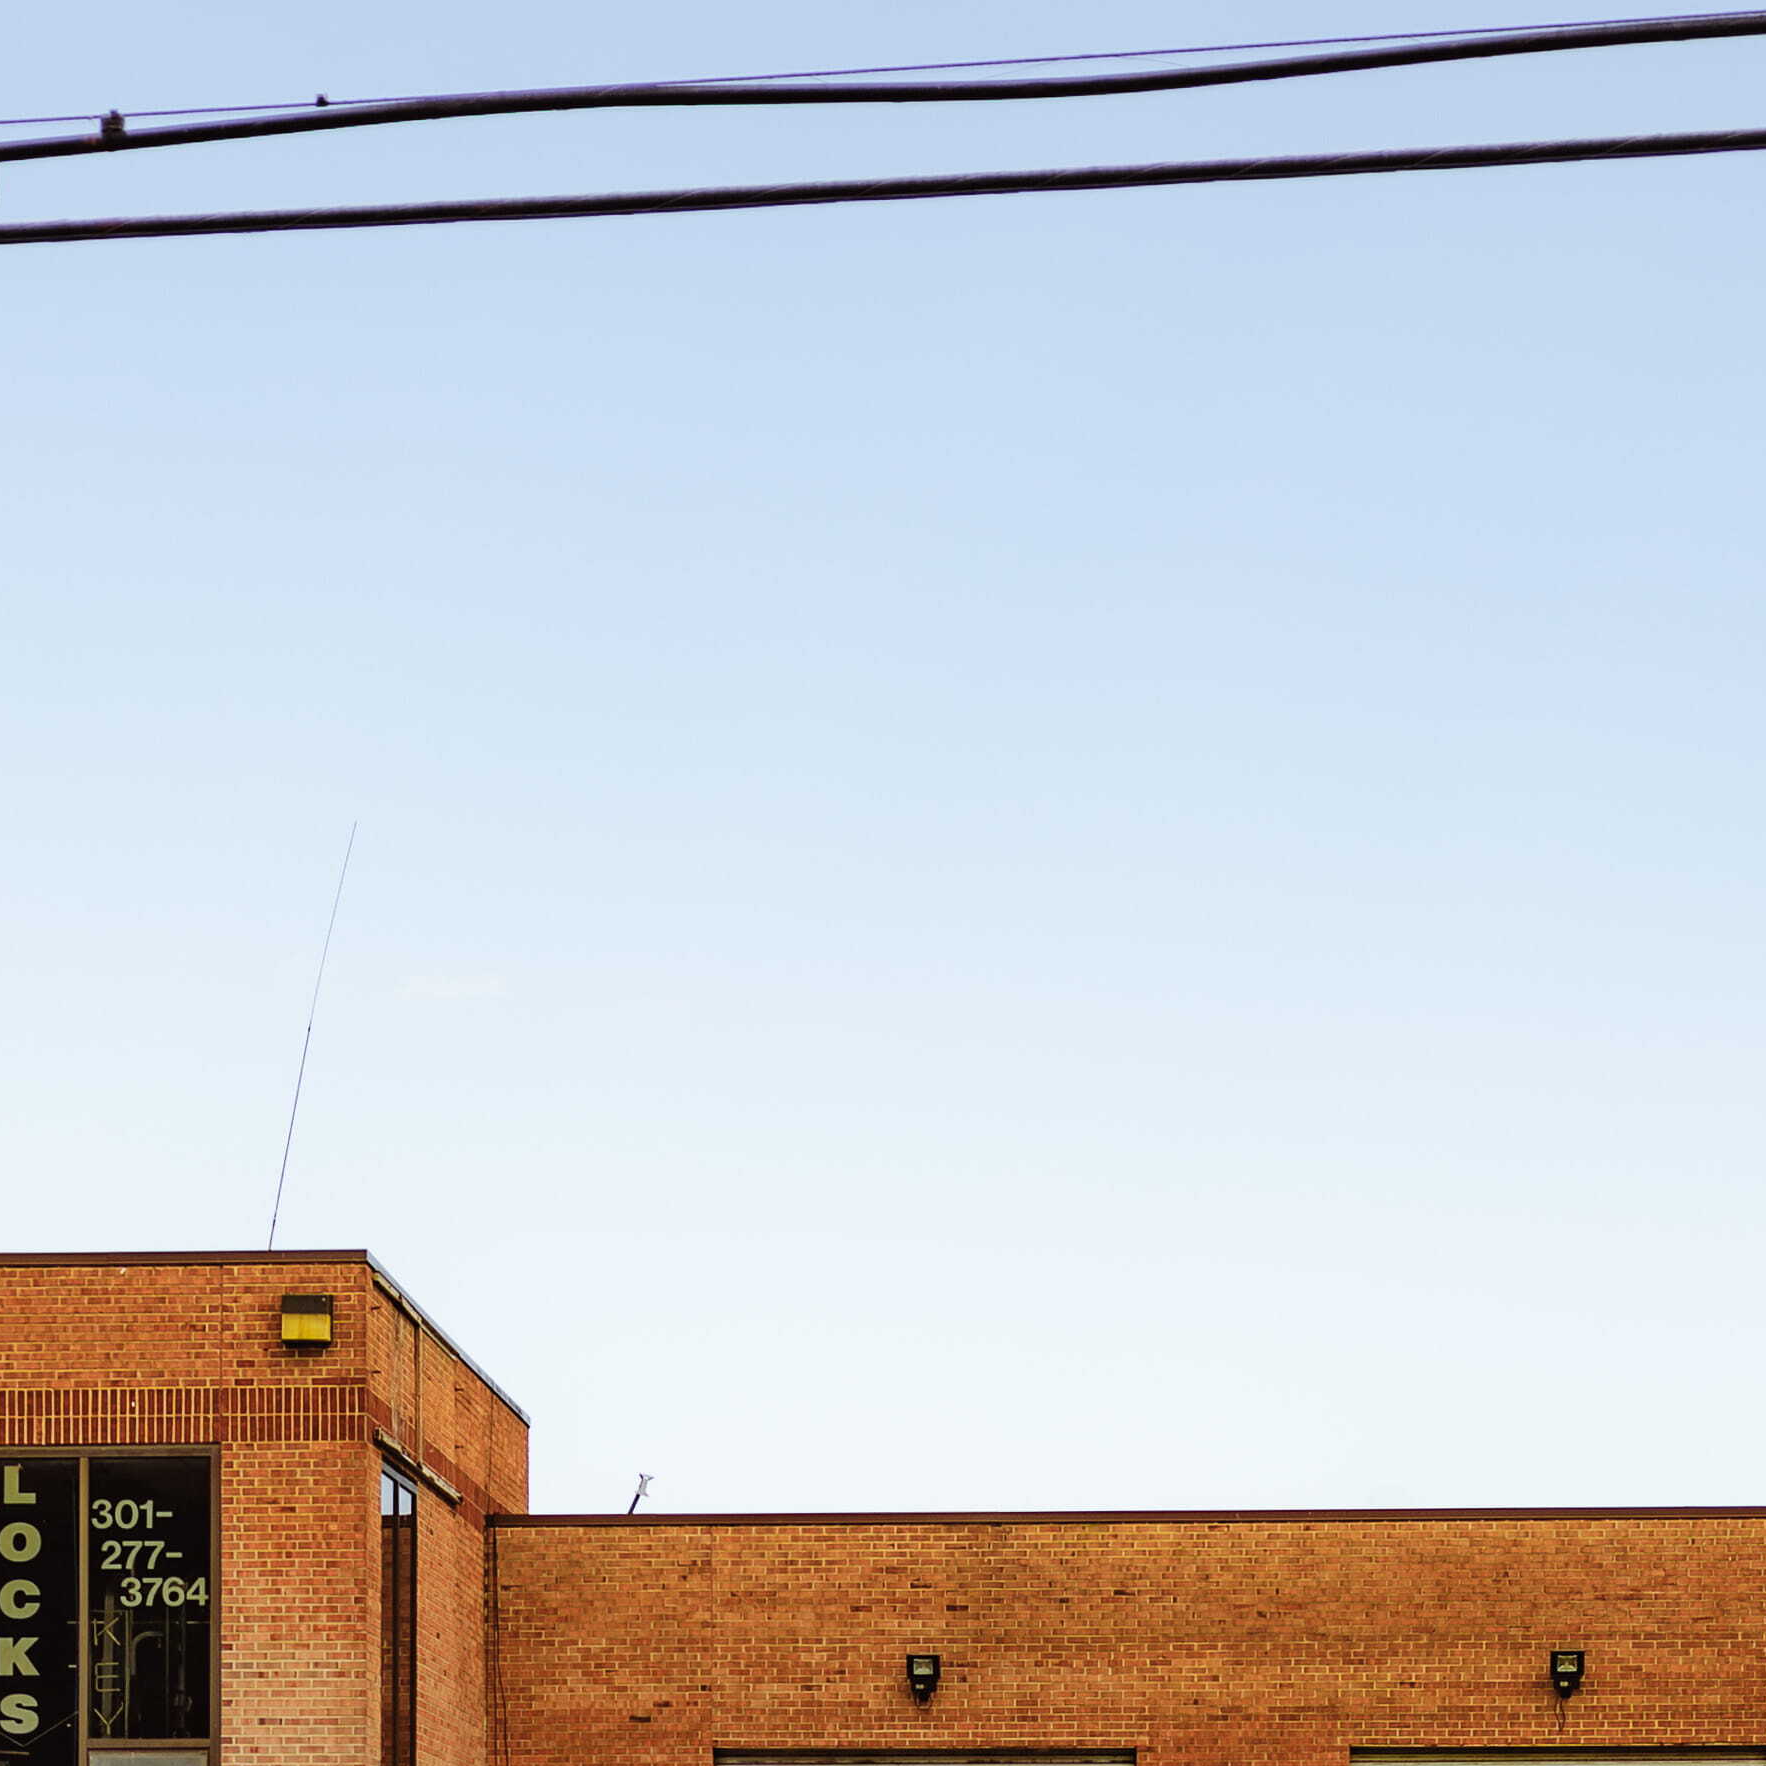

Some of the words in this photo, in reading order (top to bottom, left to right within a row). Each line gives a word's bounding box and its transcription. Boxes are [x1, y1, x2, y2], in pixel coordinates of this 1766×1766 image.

[90, 1499, 173, 1529] 301-
[100, 1540, 183, 1570] 277-
[119, 1576, 208, 1607] 3764
